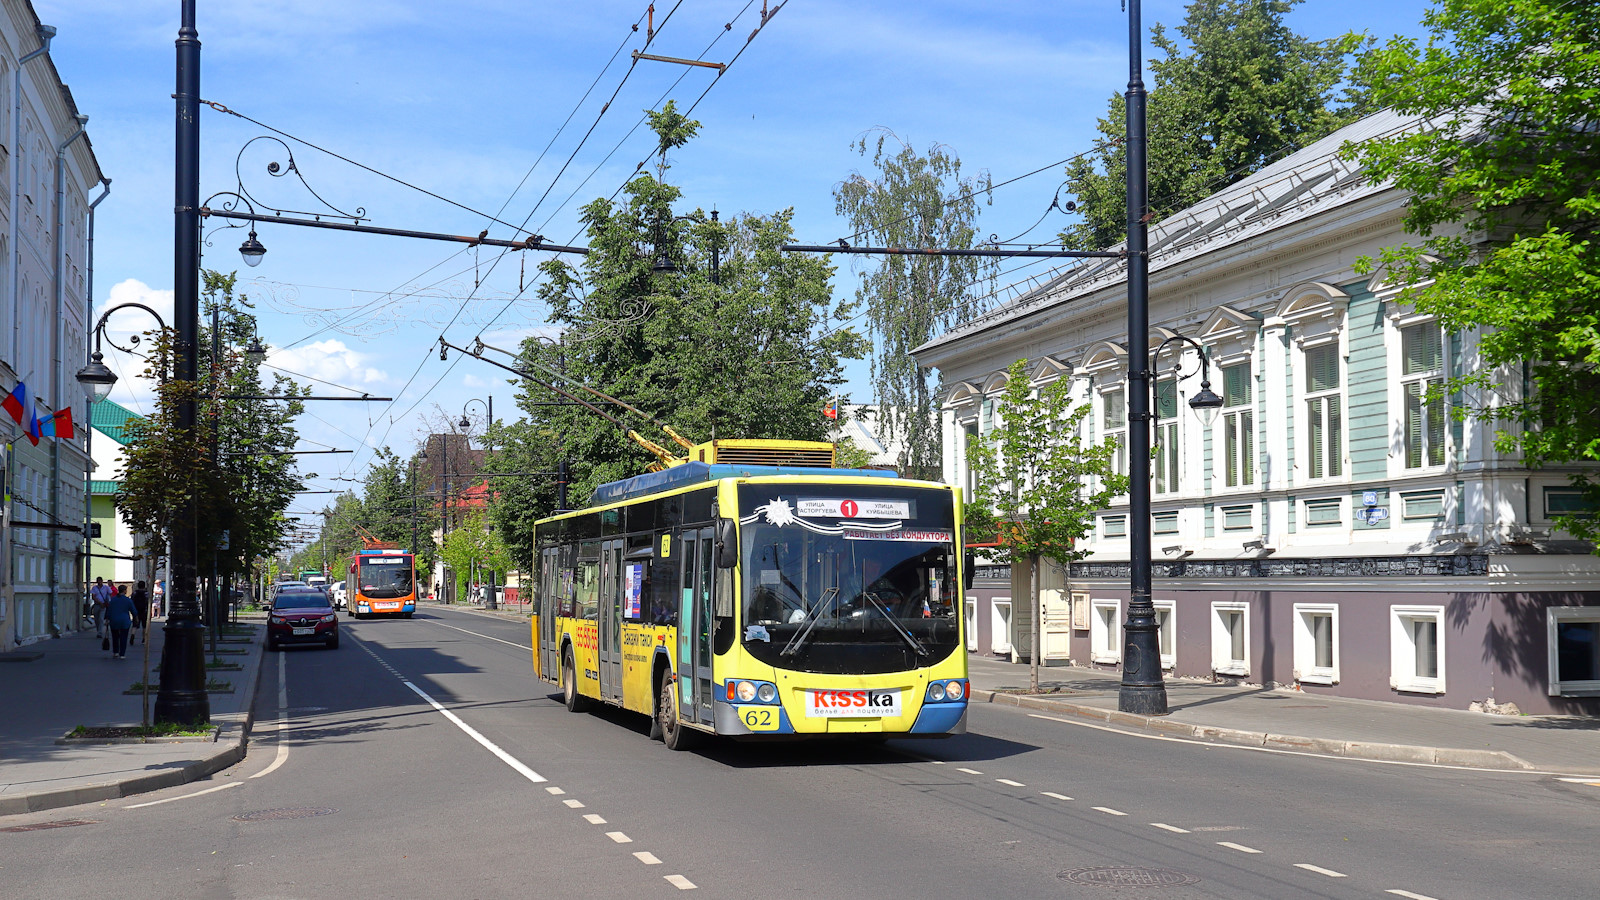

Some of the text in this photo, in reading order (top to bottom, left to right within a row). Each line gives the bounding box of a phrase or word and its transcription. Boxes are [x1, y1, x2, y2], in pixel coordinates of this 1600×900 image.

[845, 501, 853, 516] 1
[885, 531, 900, 539] БЕЗ
[901, 531, 950, 541] КОНДУКТОРА
[814, 707, 838, 715] белье
[745, 709, 771, 726] 62
